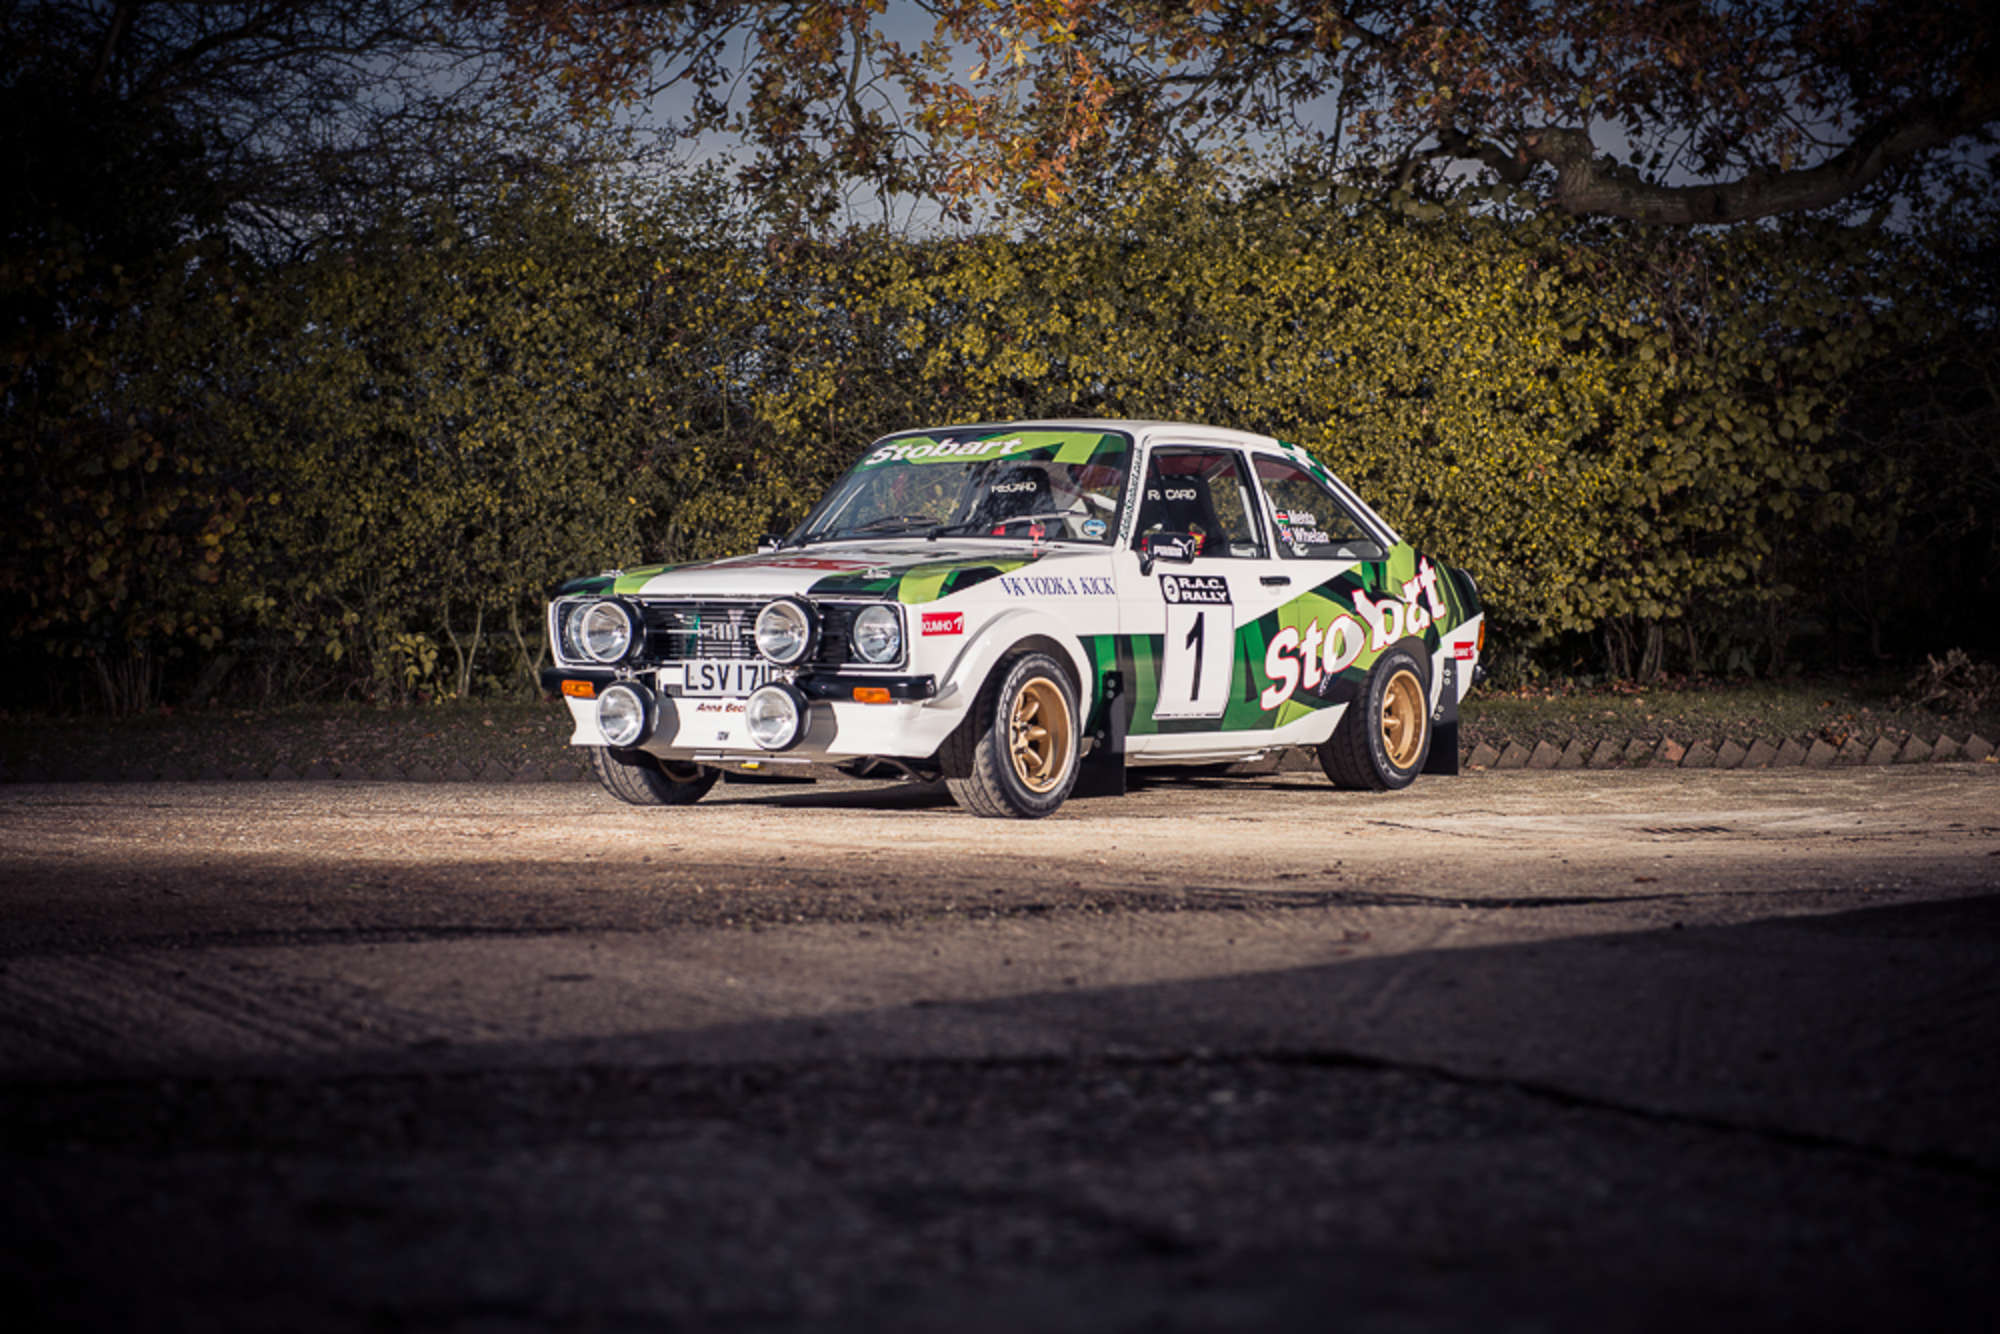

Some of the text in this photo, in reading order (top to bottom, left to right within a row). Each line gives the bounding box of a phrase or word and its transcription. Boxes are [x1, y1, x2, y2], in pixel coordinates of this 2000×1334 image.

[864, 437, 1024, 465] Stobart
[991, 481, 1037, 493] RECARO
[1147, 488, 1197, 501] RCARO
[1001, 576, 1115, 597] VK VODKA KICK
[1179, 577, 1225, 591] R.A.C.
[1181, 589, 1229, 603] RALLY
[922, 618, 953, 633] KUMHO
[1185, 611, 1205, 702] 1
[685, 664, 730, 691] LSV
[696, 703, 747, 713] Anne Bec
